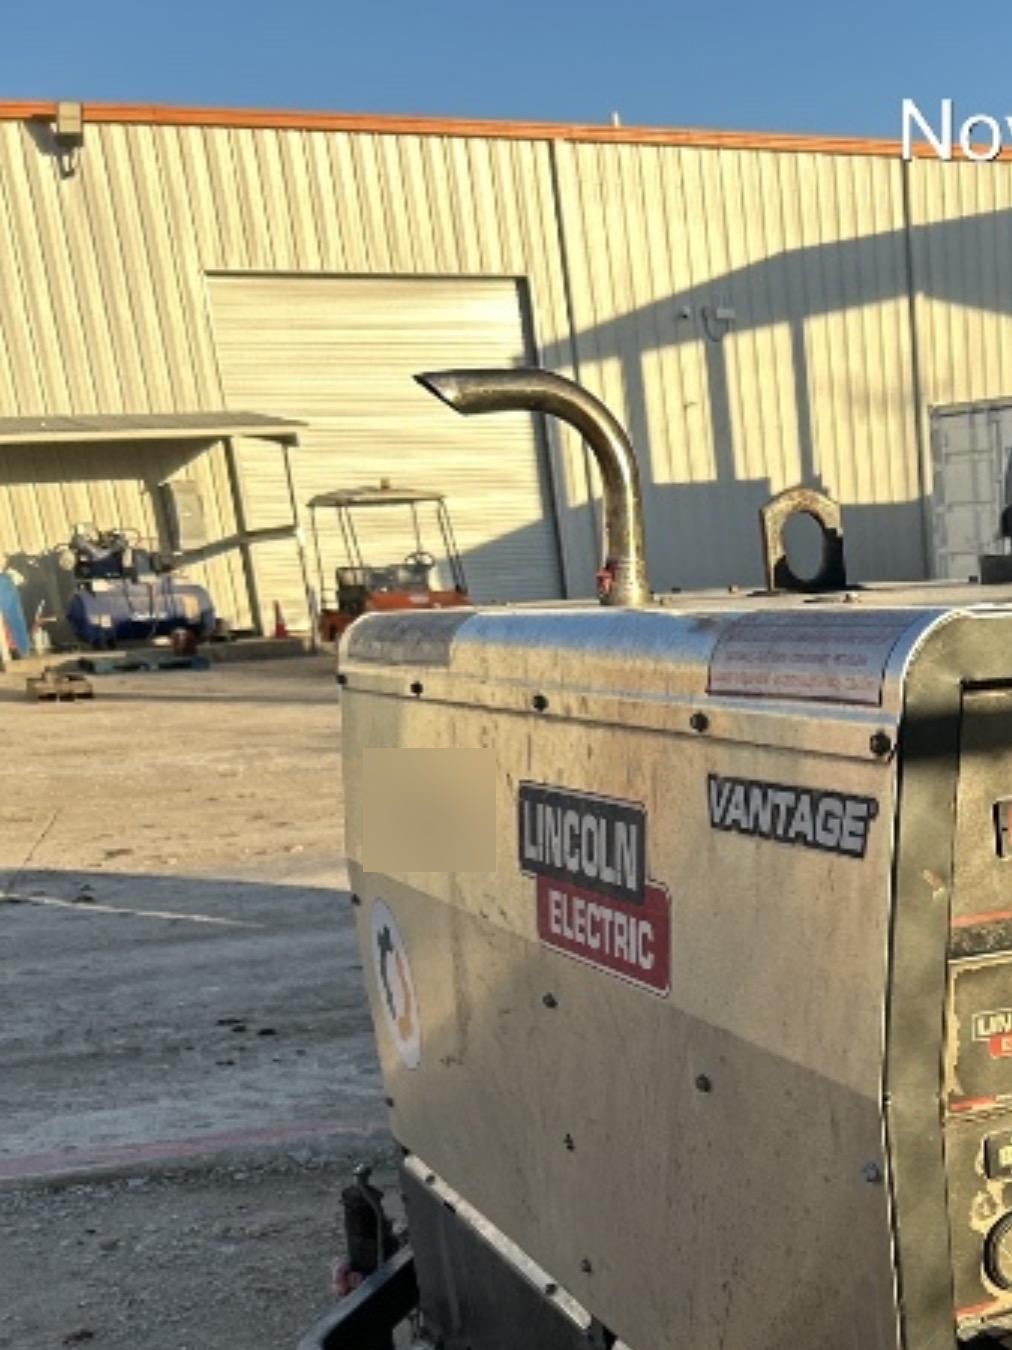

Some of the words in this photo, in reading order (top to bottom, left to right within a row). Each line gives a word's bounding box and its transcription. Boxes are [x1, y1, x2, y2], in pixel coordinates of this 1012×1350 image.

[522, 799, 639, 892] LINCOLN
[709, 780, 869, 853] VANTAGE
[547, 888, 655, 970] ELECTRIC
